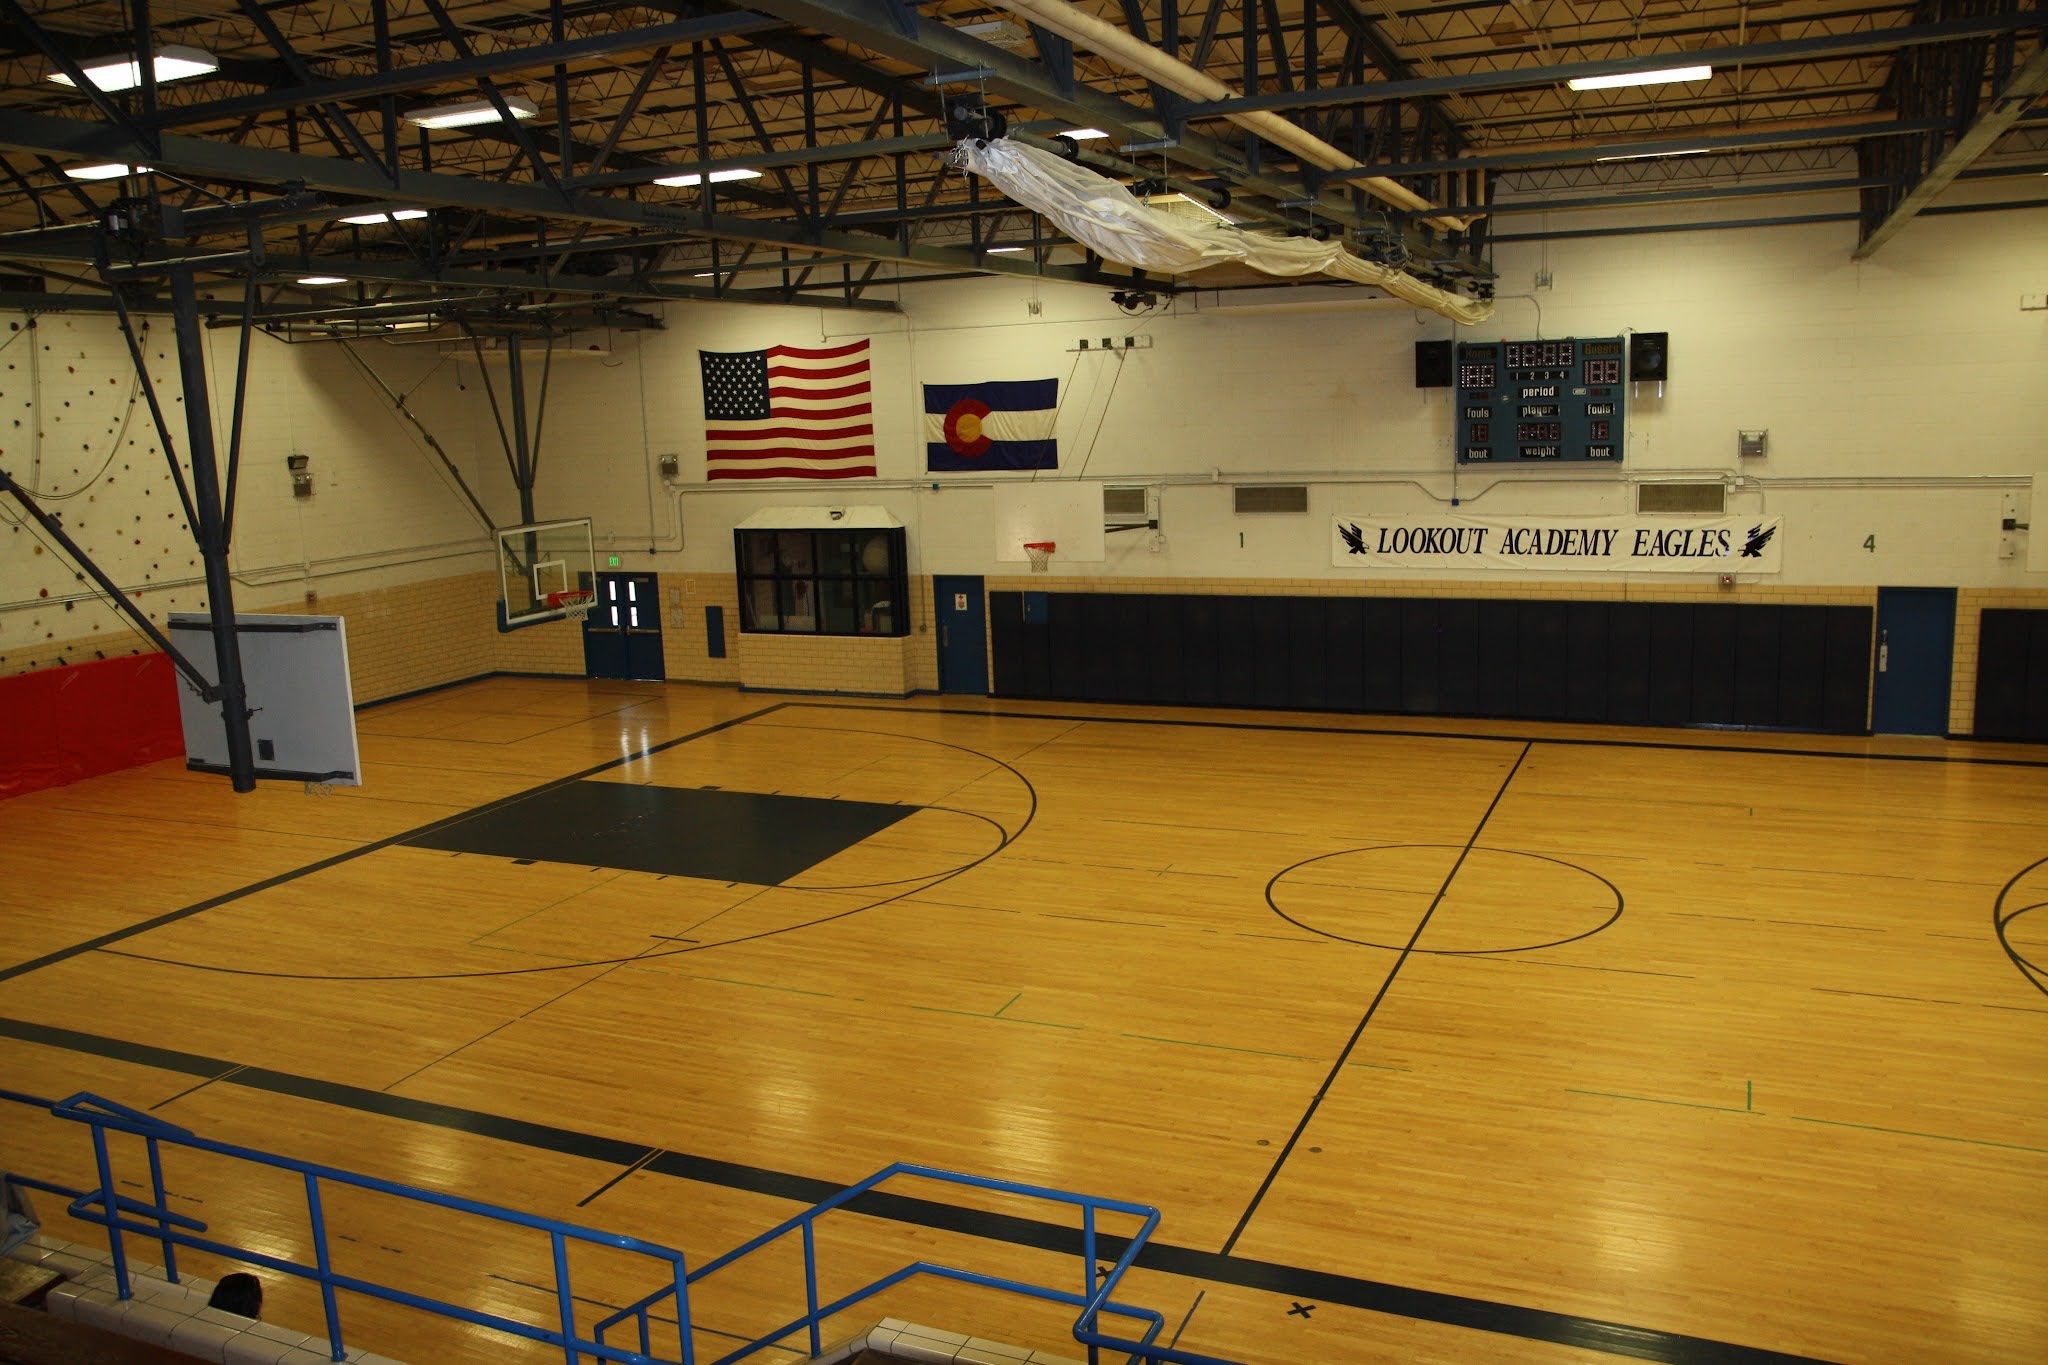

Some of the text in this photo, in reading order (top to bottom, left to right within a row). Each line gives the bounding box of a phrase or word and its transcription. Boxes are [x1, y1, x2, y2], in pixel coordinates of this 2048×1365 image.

[1522, 386, 1554, 399] period
[1467, 407, 1489, 418] fouls
[1522, 405, 1553, 417] player
[1587, 403, 1611, 415] fouls
[1468, 448, 1488, 459] bout
[1525, 446, 1556, 458] weight
[1590, 446, 1610, 457] bout
[1239, 532, 1244, 548] 1
[1376, 527, 1731, 557] LOOKOUT ACADEMY EAGLES
[1863, 534, 1876, 552] 4
